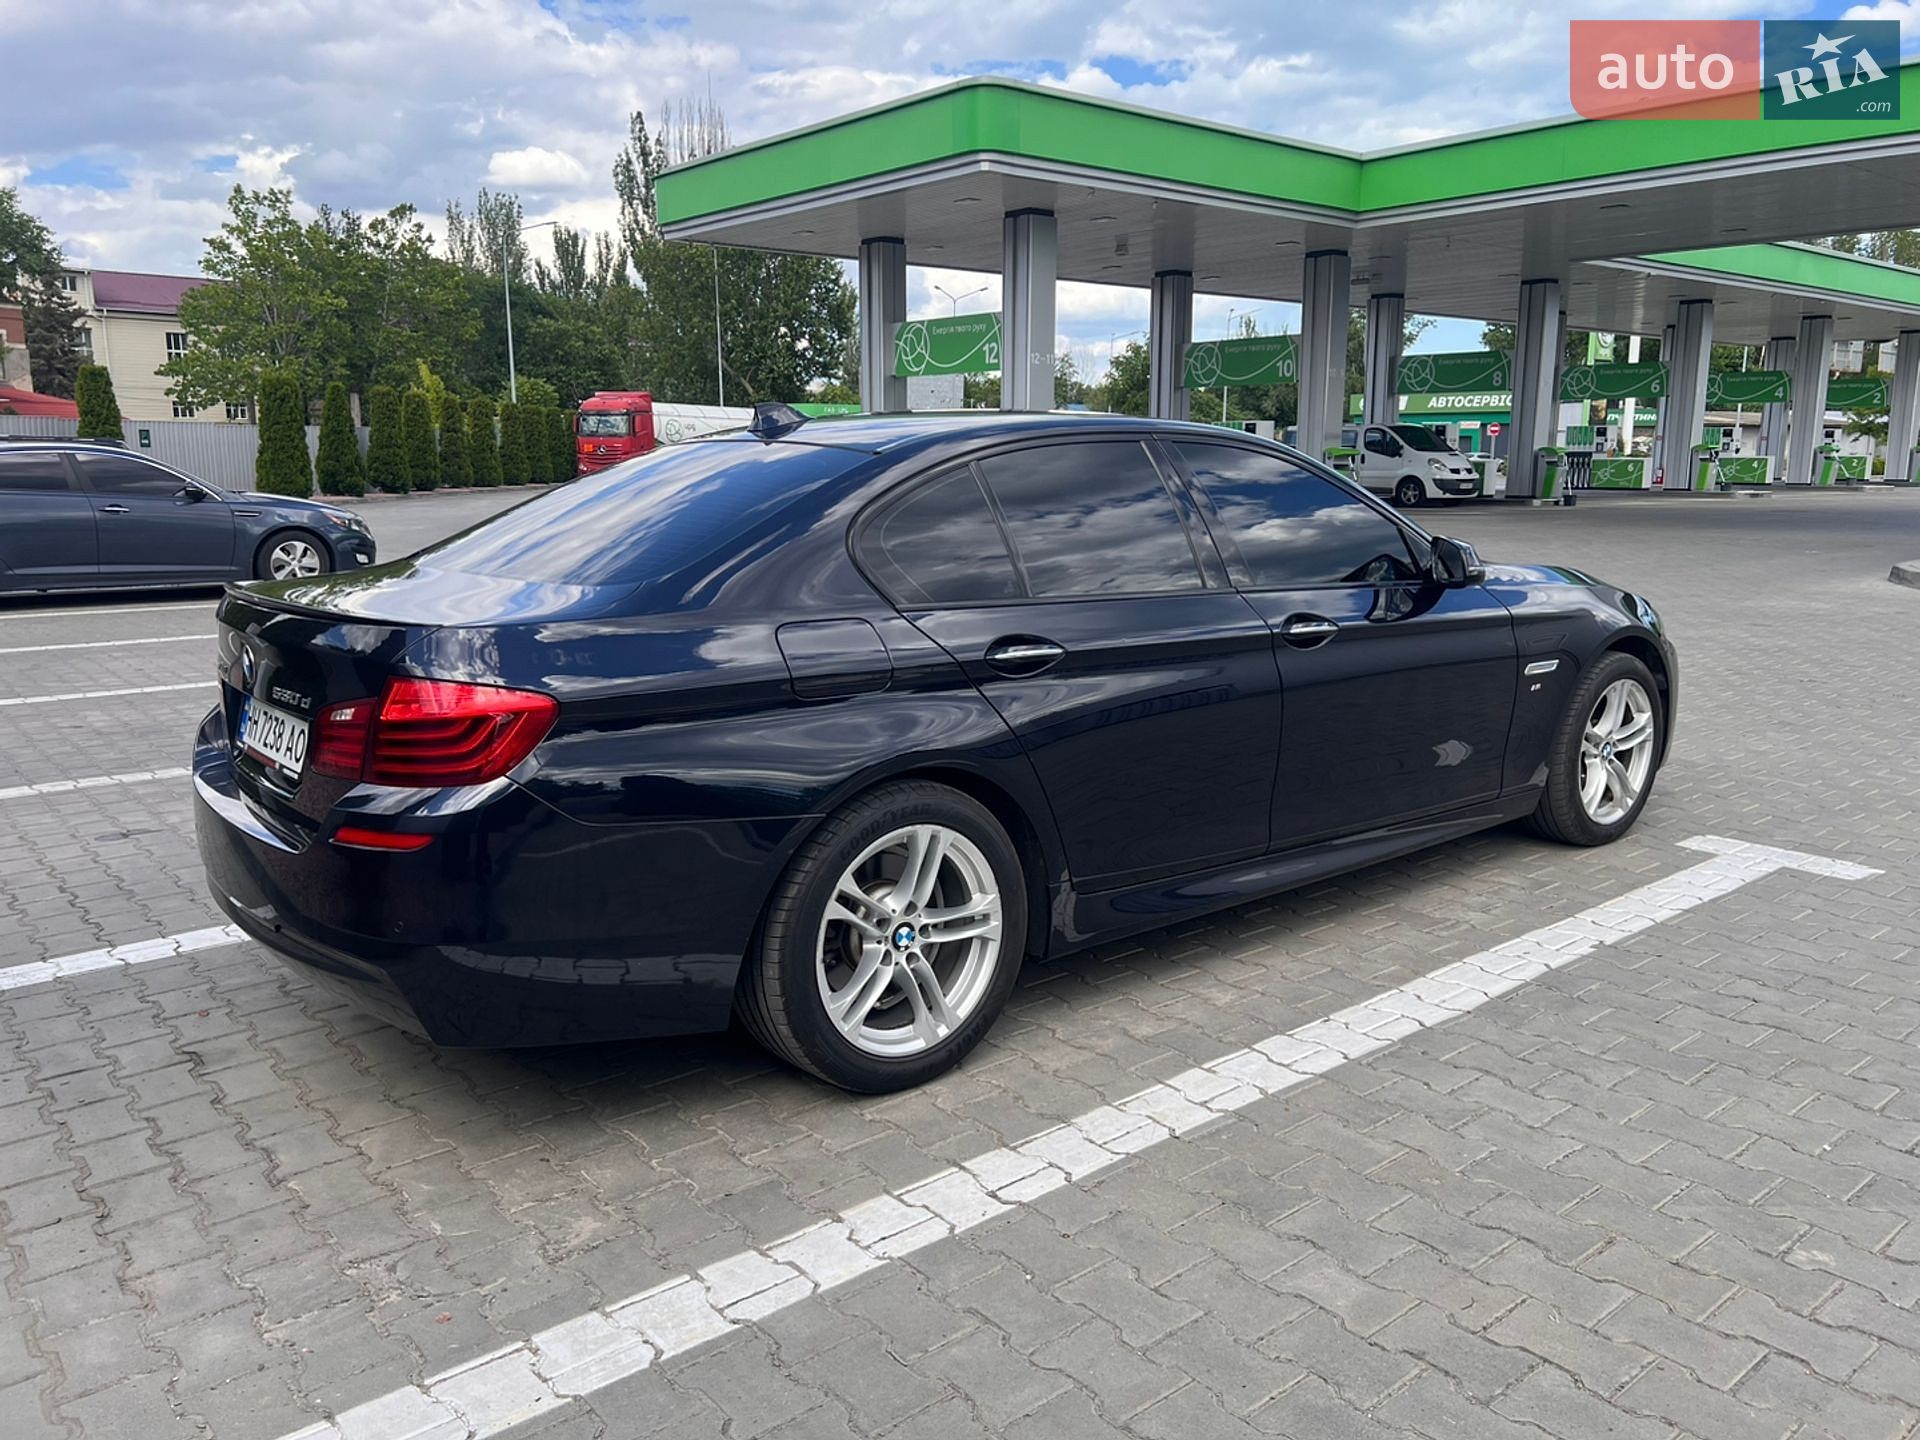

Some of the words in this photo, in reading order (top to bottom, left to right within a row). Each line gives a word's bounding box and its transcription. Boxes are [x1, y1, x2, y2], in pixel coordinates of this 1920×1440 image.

[982, 342, 998, 364] 12
[1277, 359, 1294, 377] 10
[1492, 371, 1502, 386] 8
[1651, 379, 1660, 393] 6
[1775, 387, 1784, 399] 4
[1873, 392, 1881, 404] 2
[1627, 464, 1634, 472] 6
[1752, 460, 1758, 468] 4
[284, 724, 306, 764] AO
